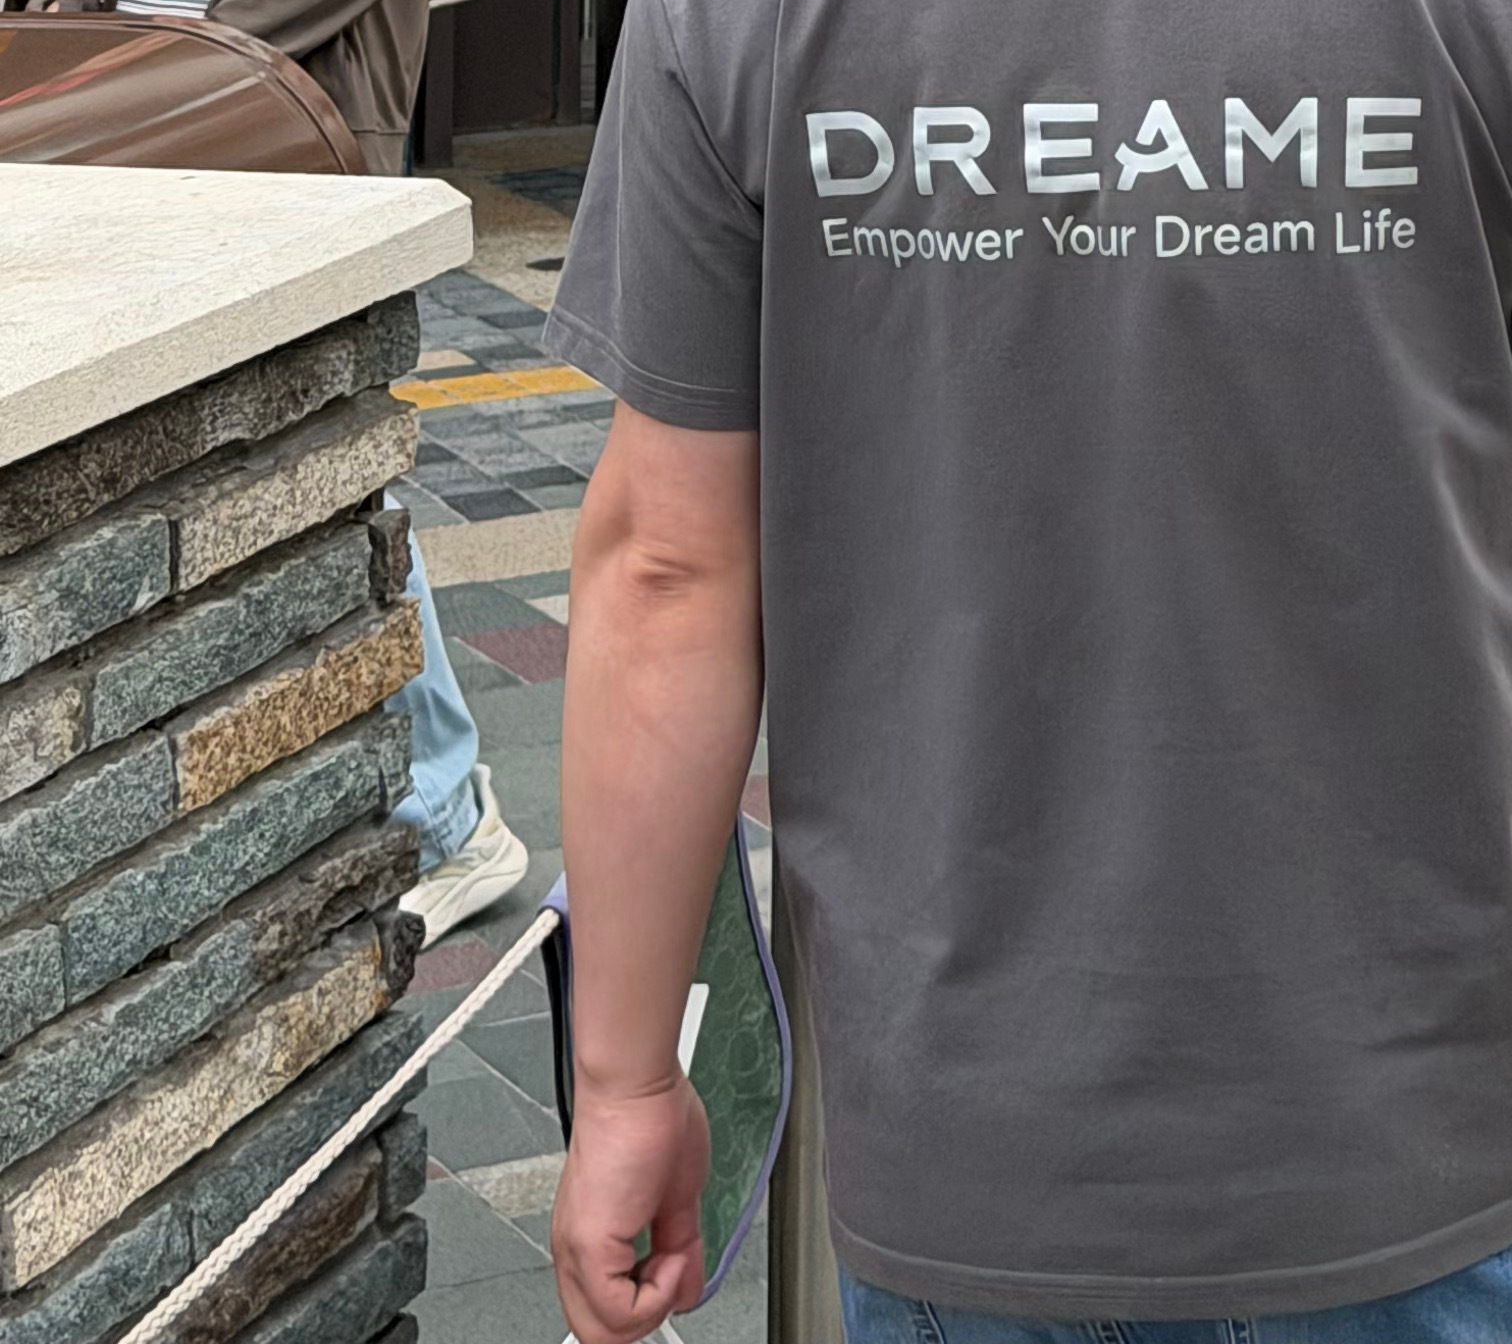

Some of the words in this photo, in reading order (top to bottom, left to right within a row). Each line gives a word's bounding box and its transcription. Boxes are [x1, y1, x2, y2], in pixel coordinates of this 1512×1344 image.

[805, 97, 1422, 197] DREAME
[821, 217, 1023, 267] Empower
[1042, 215, 1136, 257] Your
[1155, 214, 1315, 257] Dream
[1335, 209, 1416, 254] Life
